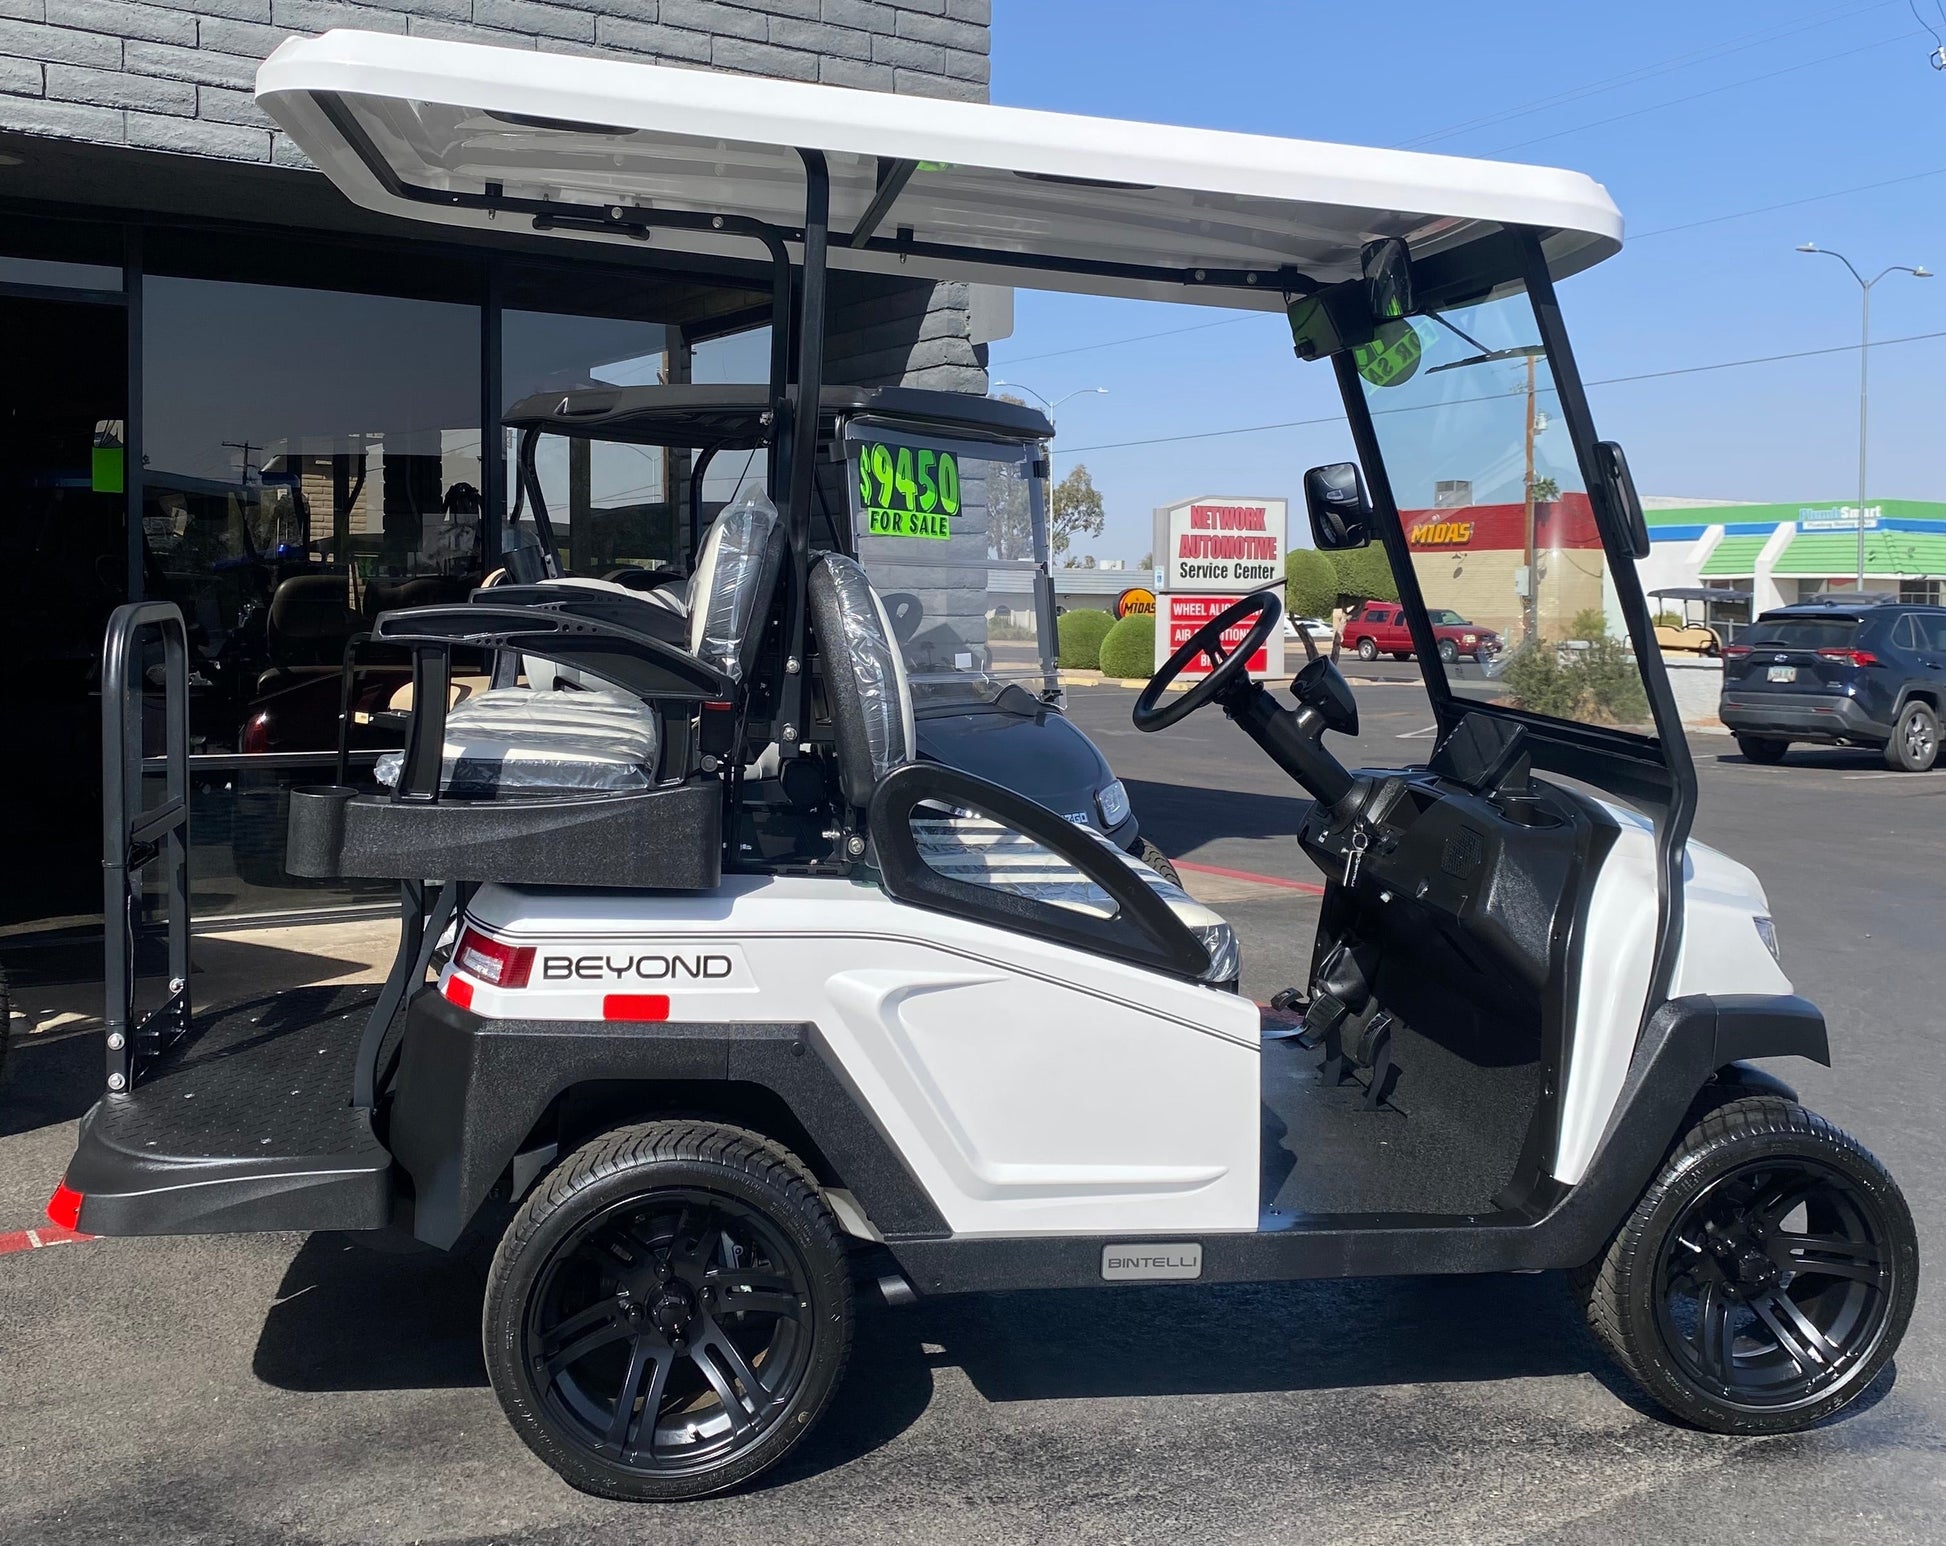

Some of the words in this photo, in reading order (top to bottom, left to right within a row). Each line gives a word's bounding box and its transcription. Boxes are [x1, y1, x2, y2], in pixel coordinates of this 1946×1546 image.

[859, 443, 960, 515] $9450
[870, 511, 902, 531] FOR
[909, 513, 948, 536] SALE
[1190, 505, 1266, 531] NETWORK
[1411, 522, 1471, 544] MIDAS
[1179, 534, 1277, 560] AUTOMOTIVE
[1180, 562, 1228, 579] Service
[1234, 563, 1275, 579] Center
[1124, 602, 1156, 614] MIDAS
[1173, 603, 1207, 616] WHEEL
[1175, 629, 1192, 642] AIR
[543, 955, 732, 980] BEYOND
[1108, 1256, 1197, 1269] BINTELLI
